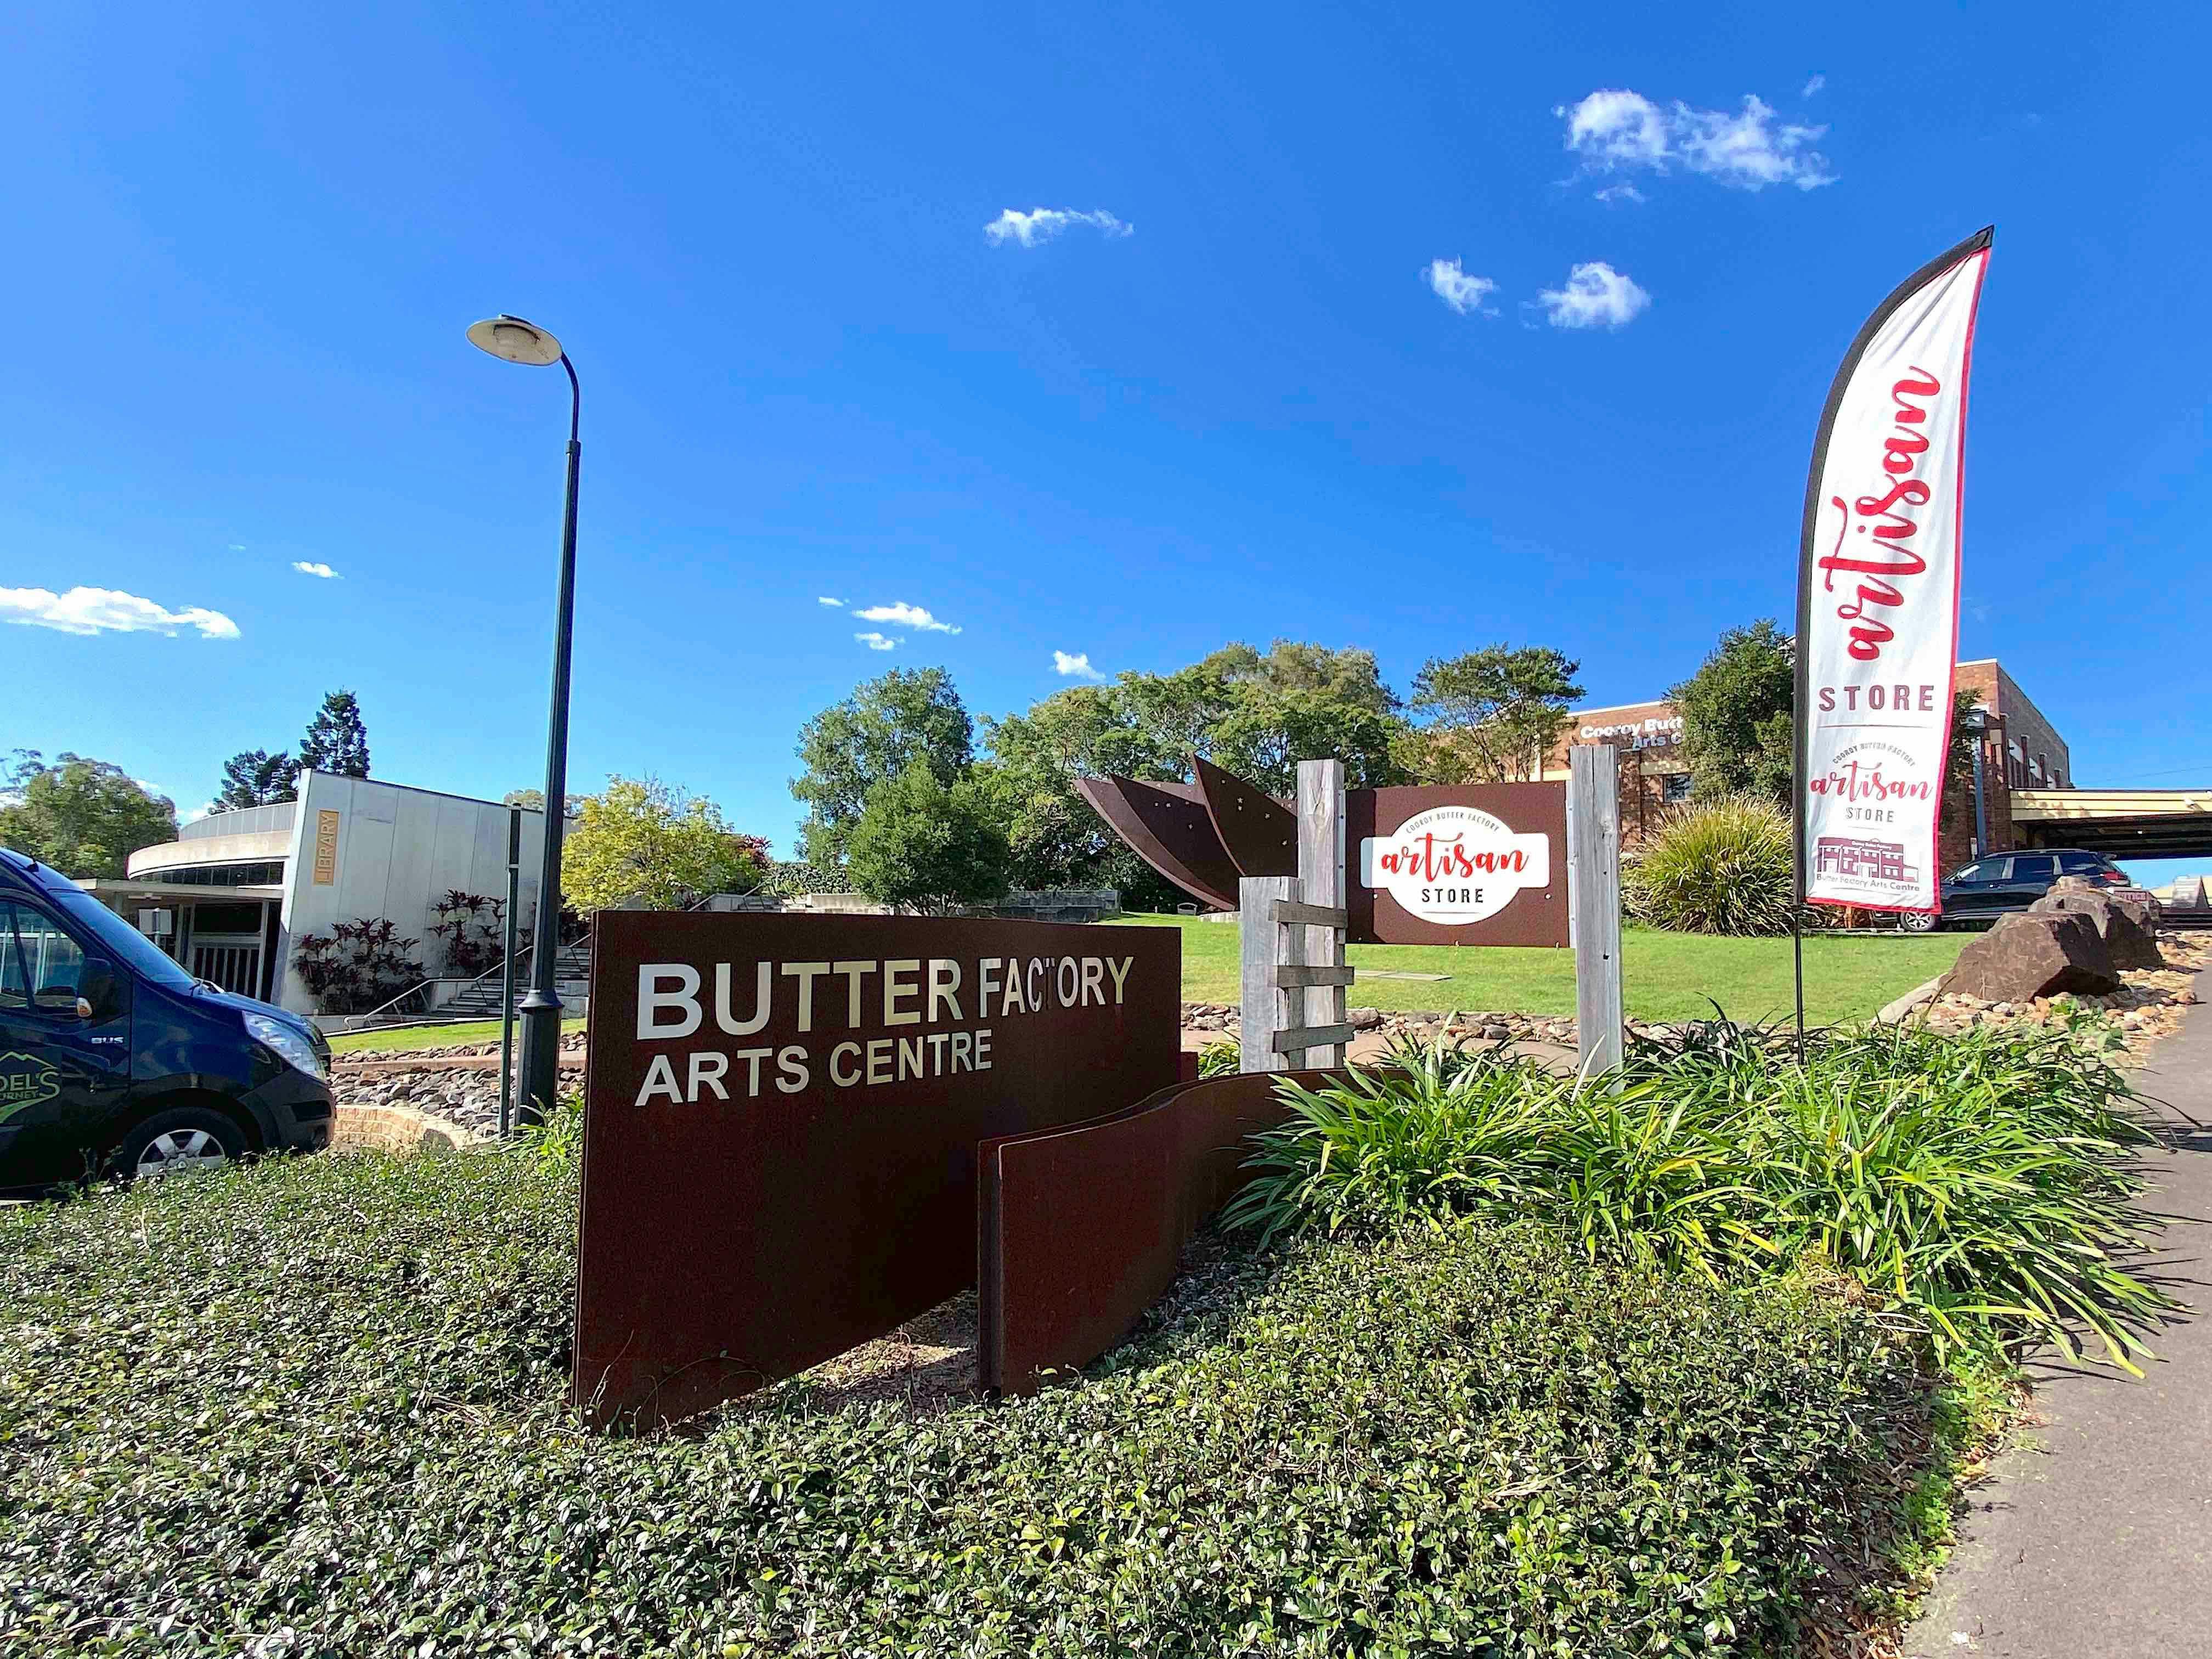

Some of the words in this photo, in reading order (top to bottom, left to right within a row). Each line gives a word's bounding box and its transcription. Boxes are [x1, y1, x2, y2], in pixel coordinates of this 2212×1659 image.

[1819, 366, 1940, 661] artisan
[1819, 685, 1934, 712] STORE
[1580, 722, 1641, 738] Cooroy
[1633, 733, 1666, 750] Arts
[1832, 745, 1857, 764] COOROY
[1888, 745, 1915, 766] FACTORY
[1810, 760, 1933, 802] artisan
[1406, 816, 1432, 833] COOROY
[1436, 812, 1464, 820] BUTTER
[1468, 814, 1499, 832] FACTORY
[1846, 807, 1894, 823] STORE
[317, 813, 335, 883] LIBRARY
[1381, 832, 1530, 882] artisan
[1816, 874, 1837, 882] Butter
[1840, 876, 1867, 888] Factory
[1870, 879, 1887, 888] Arts
[1890, 882, 1920, 891] Centre
[1422, 889, 1483, 903] STORE
[637, 959, 963, 1040] BUTTER
[979, 956, 1134, 1018] FACTORY
[634, 1045, 810, 1107] ARTS
[830, 1029, 992, 1087] CENTRE
